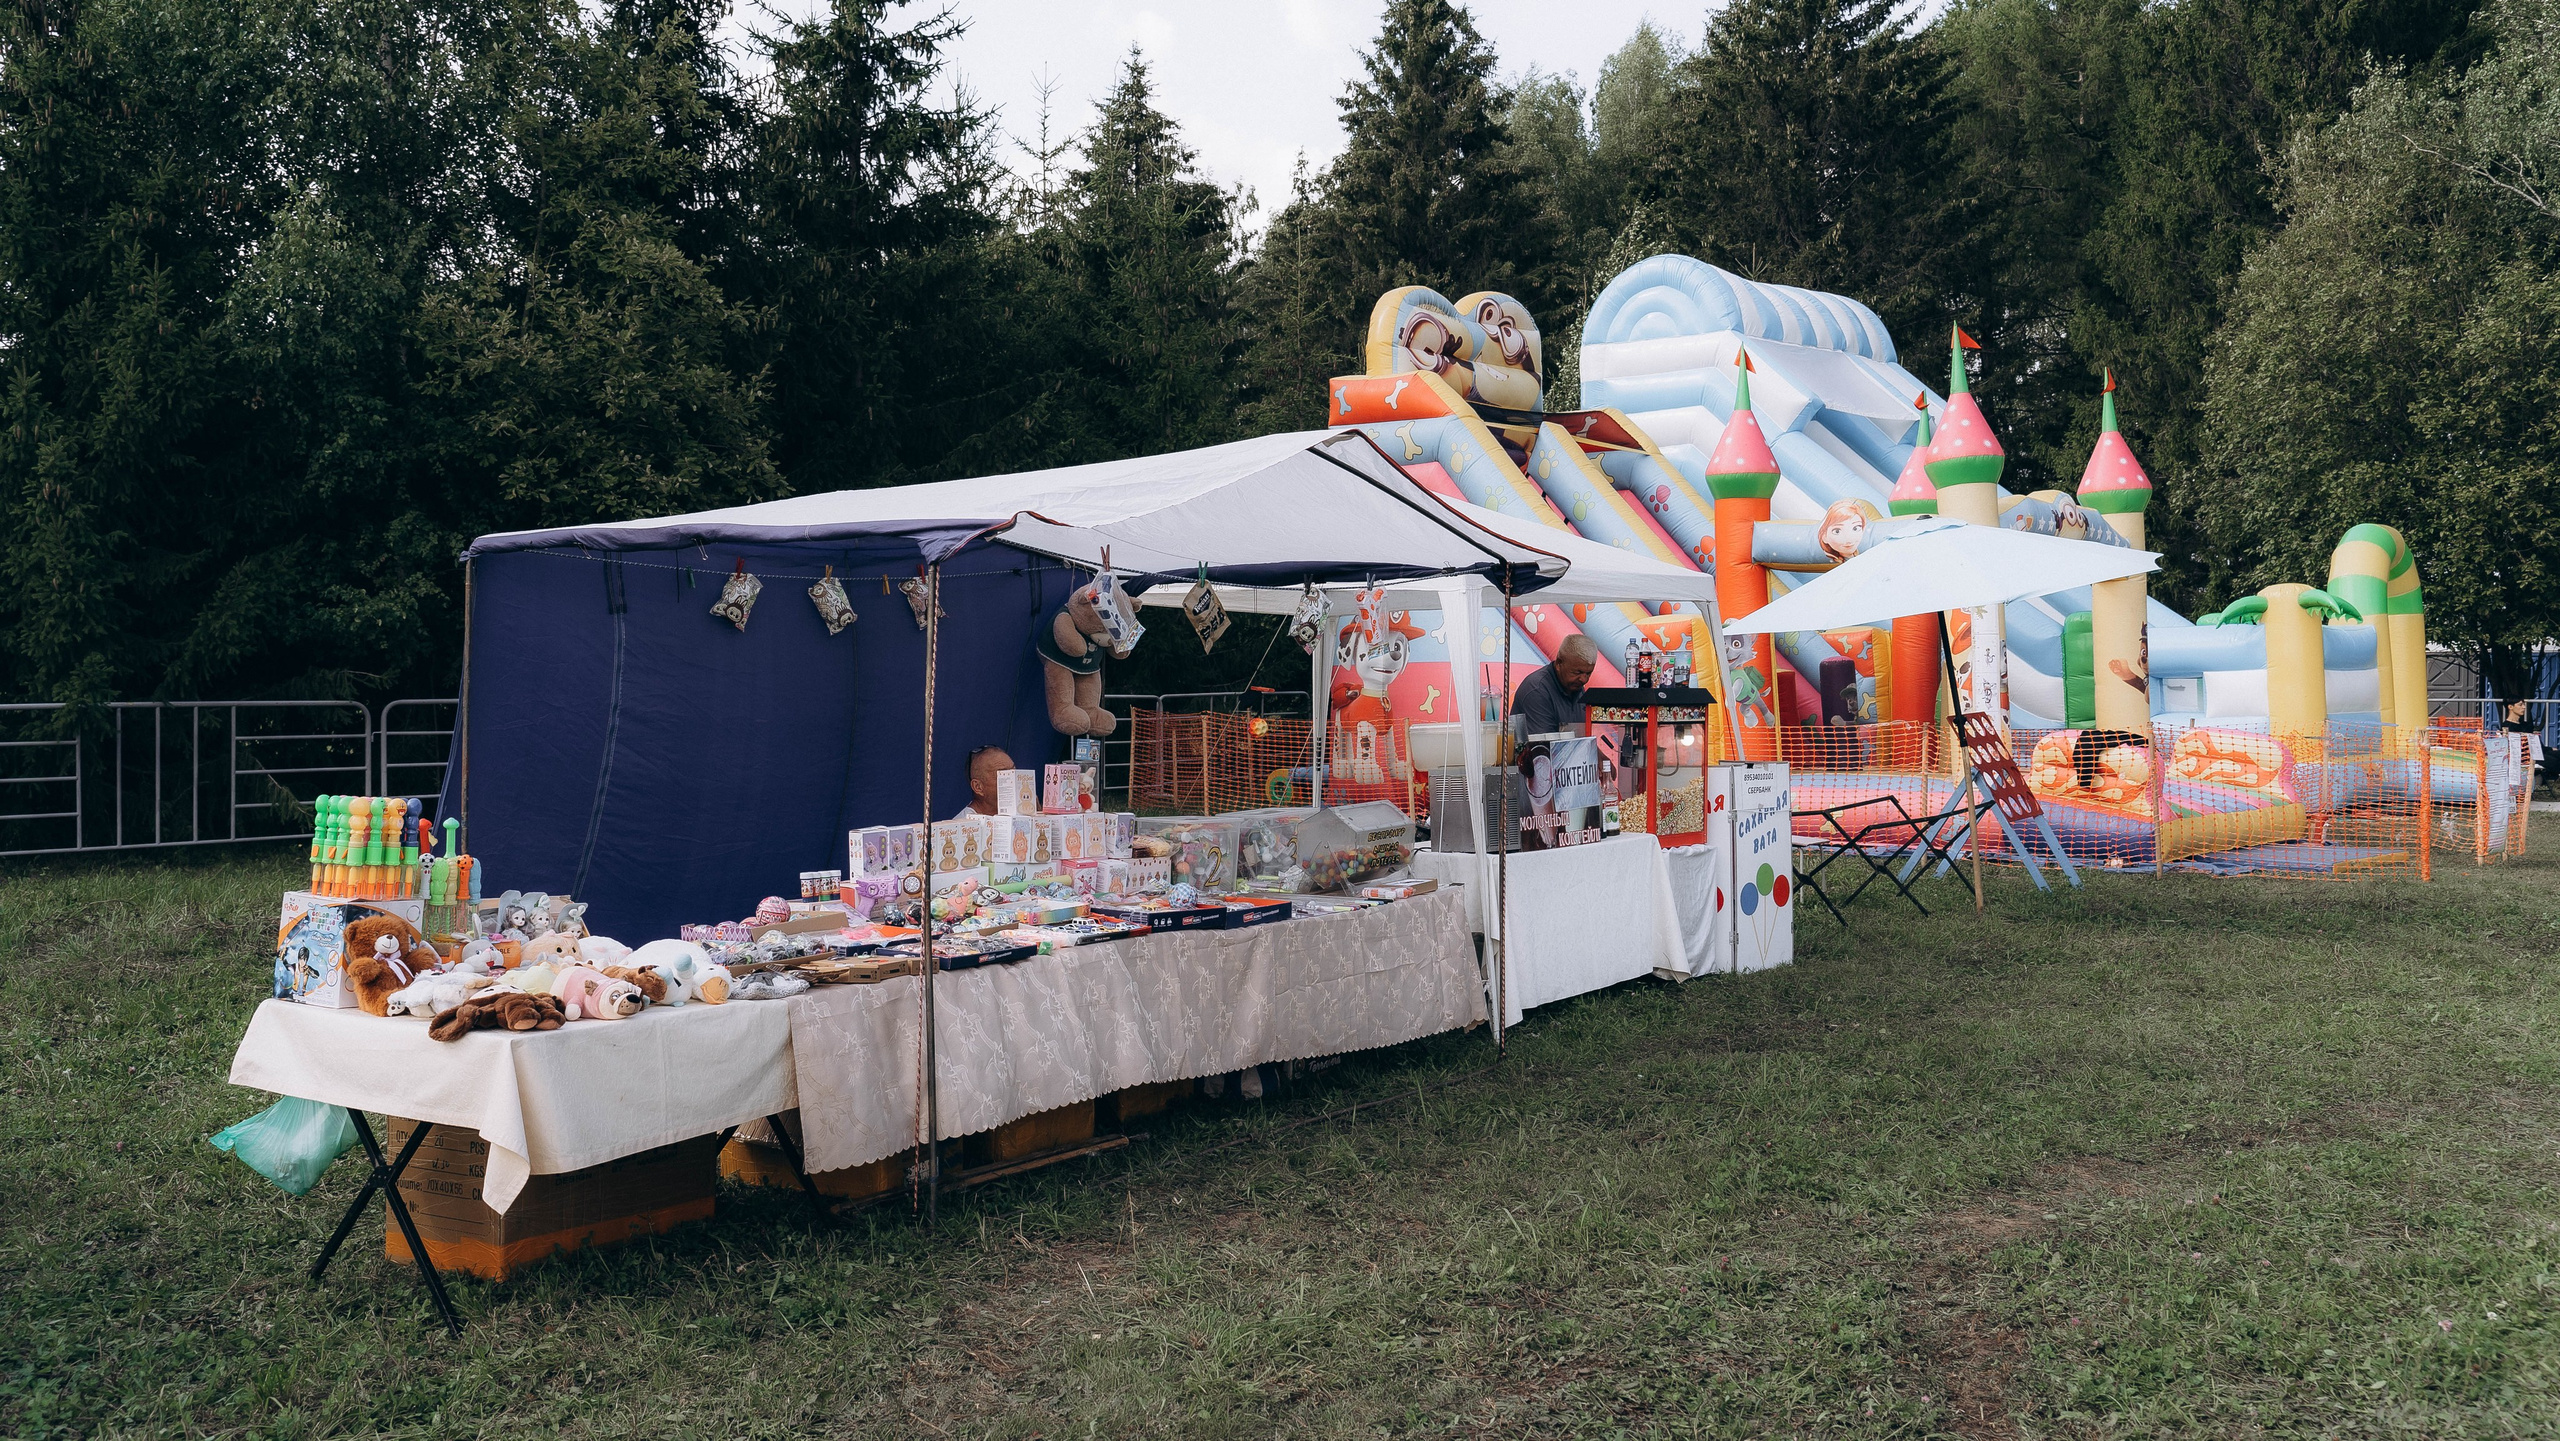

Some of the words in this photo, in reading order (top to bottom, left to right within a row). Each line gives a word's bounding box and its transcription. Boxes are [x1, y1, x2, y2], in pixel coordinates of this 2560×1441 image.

[1747, 786, 1771, 794] СБЕРБАНК
[1753, 828, 1777, 854] ВАТА
[1204, 846, 1223, 887] 2
[470, 1141, 485, 1155] PCS
[469, 1164, 485, 1178] KGS
